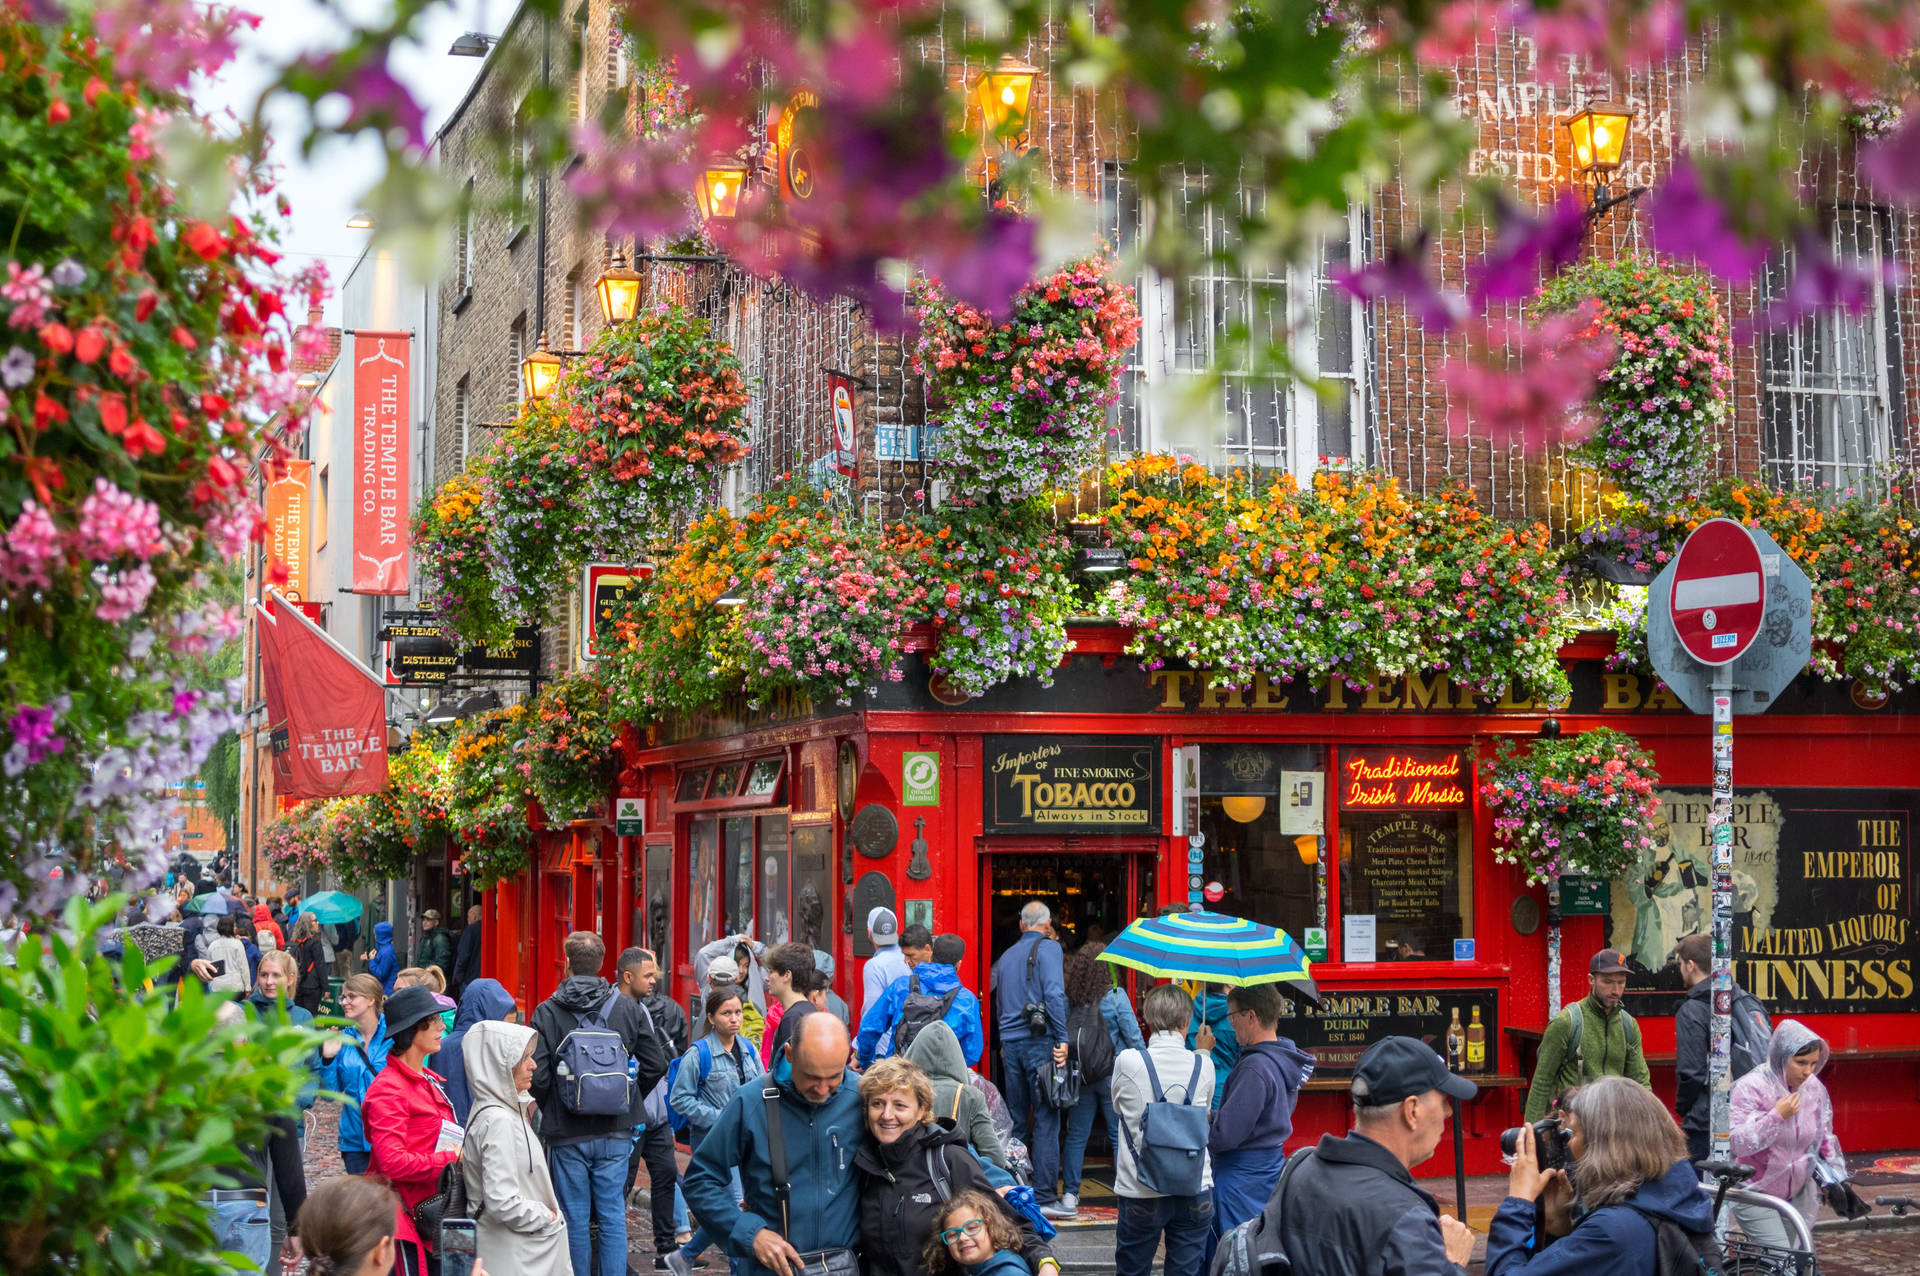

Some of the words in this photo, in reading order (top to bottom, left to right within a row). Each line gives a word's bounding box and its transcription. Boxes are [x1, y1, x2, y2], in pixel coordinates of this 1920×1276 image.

[381, 374, 397, 415] THE
[363, 403, 377, 484] TRADING
[380, 420, 397, 500] TEMPLE
[288, 493, 300, 524] THE
[363, 489, 376, 516] CO.
[380, 505, 396, 545] BAR
[274, 515, 285, 563] TRADI
[287, 529, 300, 588] TEMPLE
[389, 626, 409, 636] THE
[411, 627, 441, 637] TEMPL
[402, 656, 458, 665] DISTILLERY
[414, 671, 446, 680] STORE
[1151, 670, 1289, 709] THE
[1603, 673, 1684, 710] BA
[321, 727, 356, 741] THE
[297, 736, 382, 760] TEMPLE
[991, 743, 1062, 774] Importers
[320, 756, 364, 774] BAR
[1035, 761, 1048, 770] OF
[1054, 767, 1080, 778] FINE
[1082, 767, 1135, 778] SMOKING
[1349, 754, 1459, 780] Traditional
[1010, 773, 1136, 818] TOBACCO
[1346, 782, 1396, 805] Irish
[1407, 781, 1465, 804] Music
[1036, 810, 1084, 821] Always
[1091, 810, 1104, 820] in
[1108, 810, 1146, 821] Stock
[1665, 803, 1776, 824] TEPLE
[1367, 820, 1418, 844] TEMPLE
[1422, 823, 1446, 845] BAR
[1700, 826, 1751, 849] BR
[1857, 819, 1901, 846] THE
[1803, 851, 1901, 879] EMPEROR
[1877, 883, 1901, 911] OF
[1740, 926, 1824, 956] MALTED
[1826, 912, 1911, 950] LIQUORS
[1731, 960, 1914, 1000] UINNESS
[1397, 995, 1443, 1016] BAR
[1323, 1019, 1370, 1031] DUBLIN
[1328, 1033, 1346, 1042] EST.
[1349, 1033, 1365, 1042] 1840
